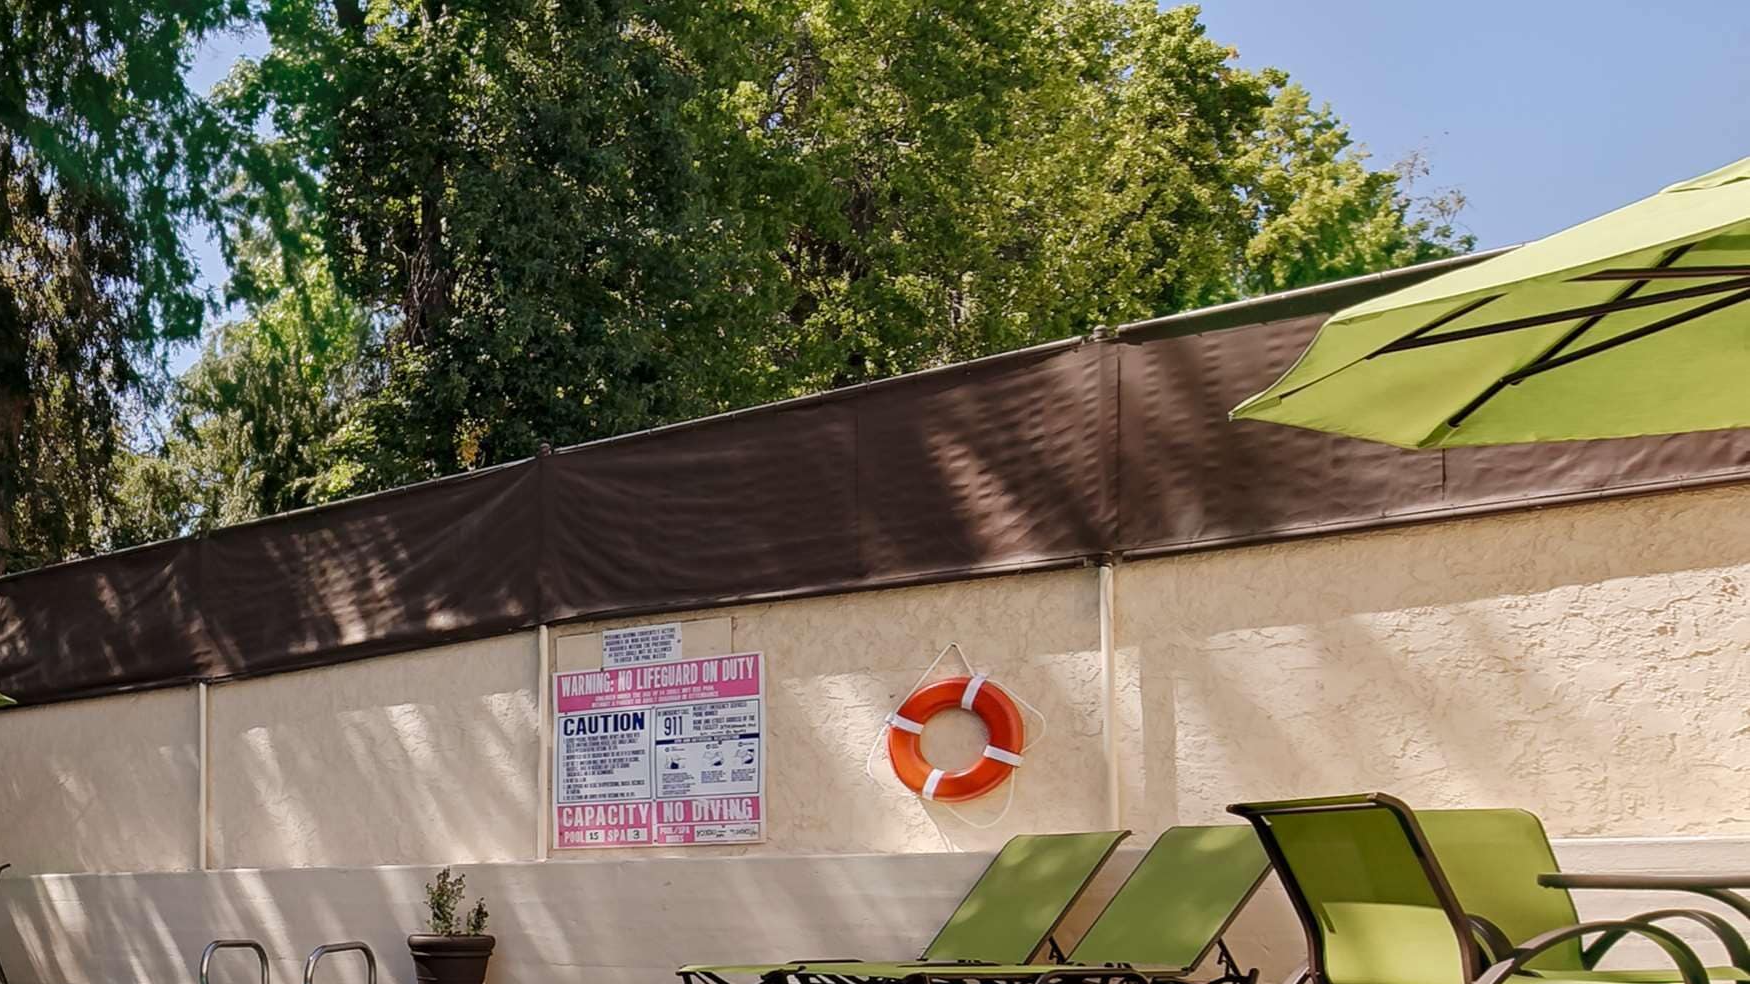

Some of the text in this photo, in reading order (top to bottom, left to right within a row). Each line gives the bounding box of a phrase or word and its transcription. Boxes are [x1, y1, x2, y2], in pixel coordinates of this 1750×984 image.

[561, 673, 614, 697] WARNING:
[618, 669, 633, 692] NO
[636, 662, 698, 690] LIFEGUARD
[702, 661, 718, 683] ON
[722, 656, 755, 682] DUTY
[563, 712, 645, 736] CAUTION
[664, 715, 683, 736] 911
[562, 803, 649, 827] CAPACITY
[663, 798, 753, 822] NO DIVING
[564, 828, 640, 843] POOL 15 SPA 3
